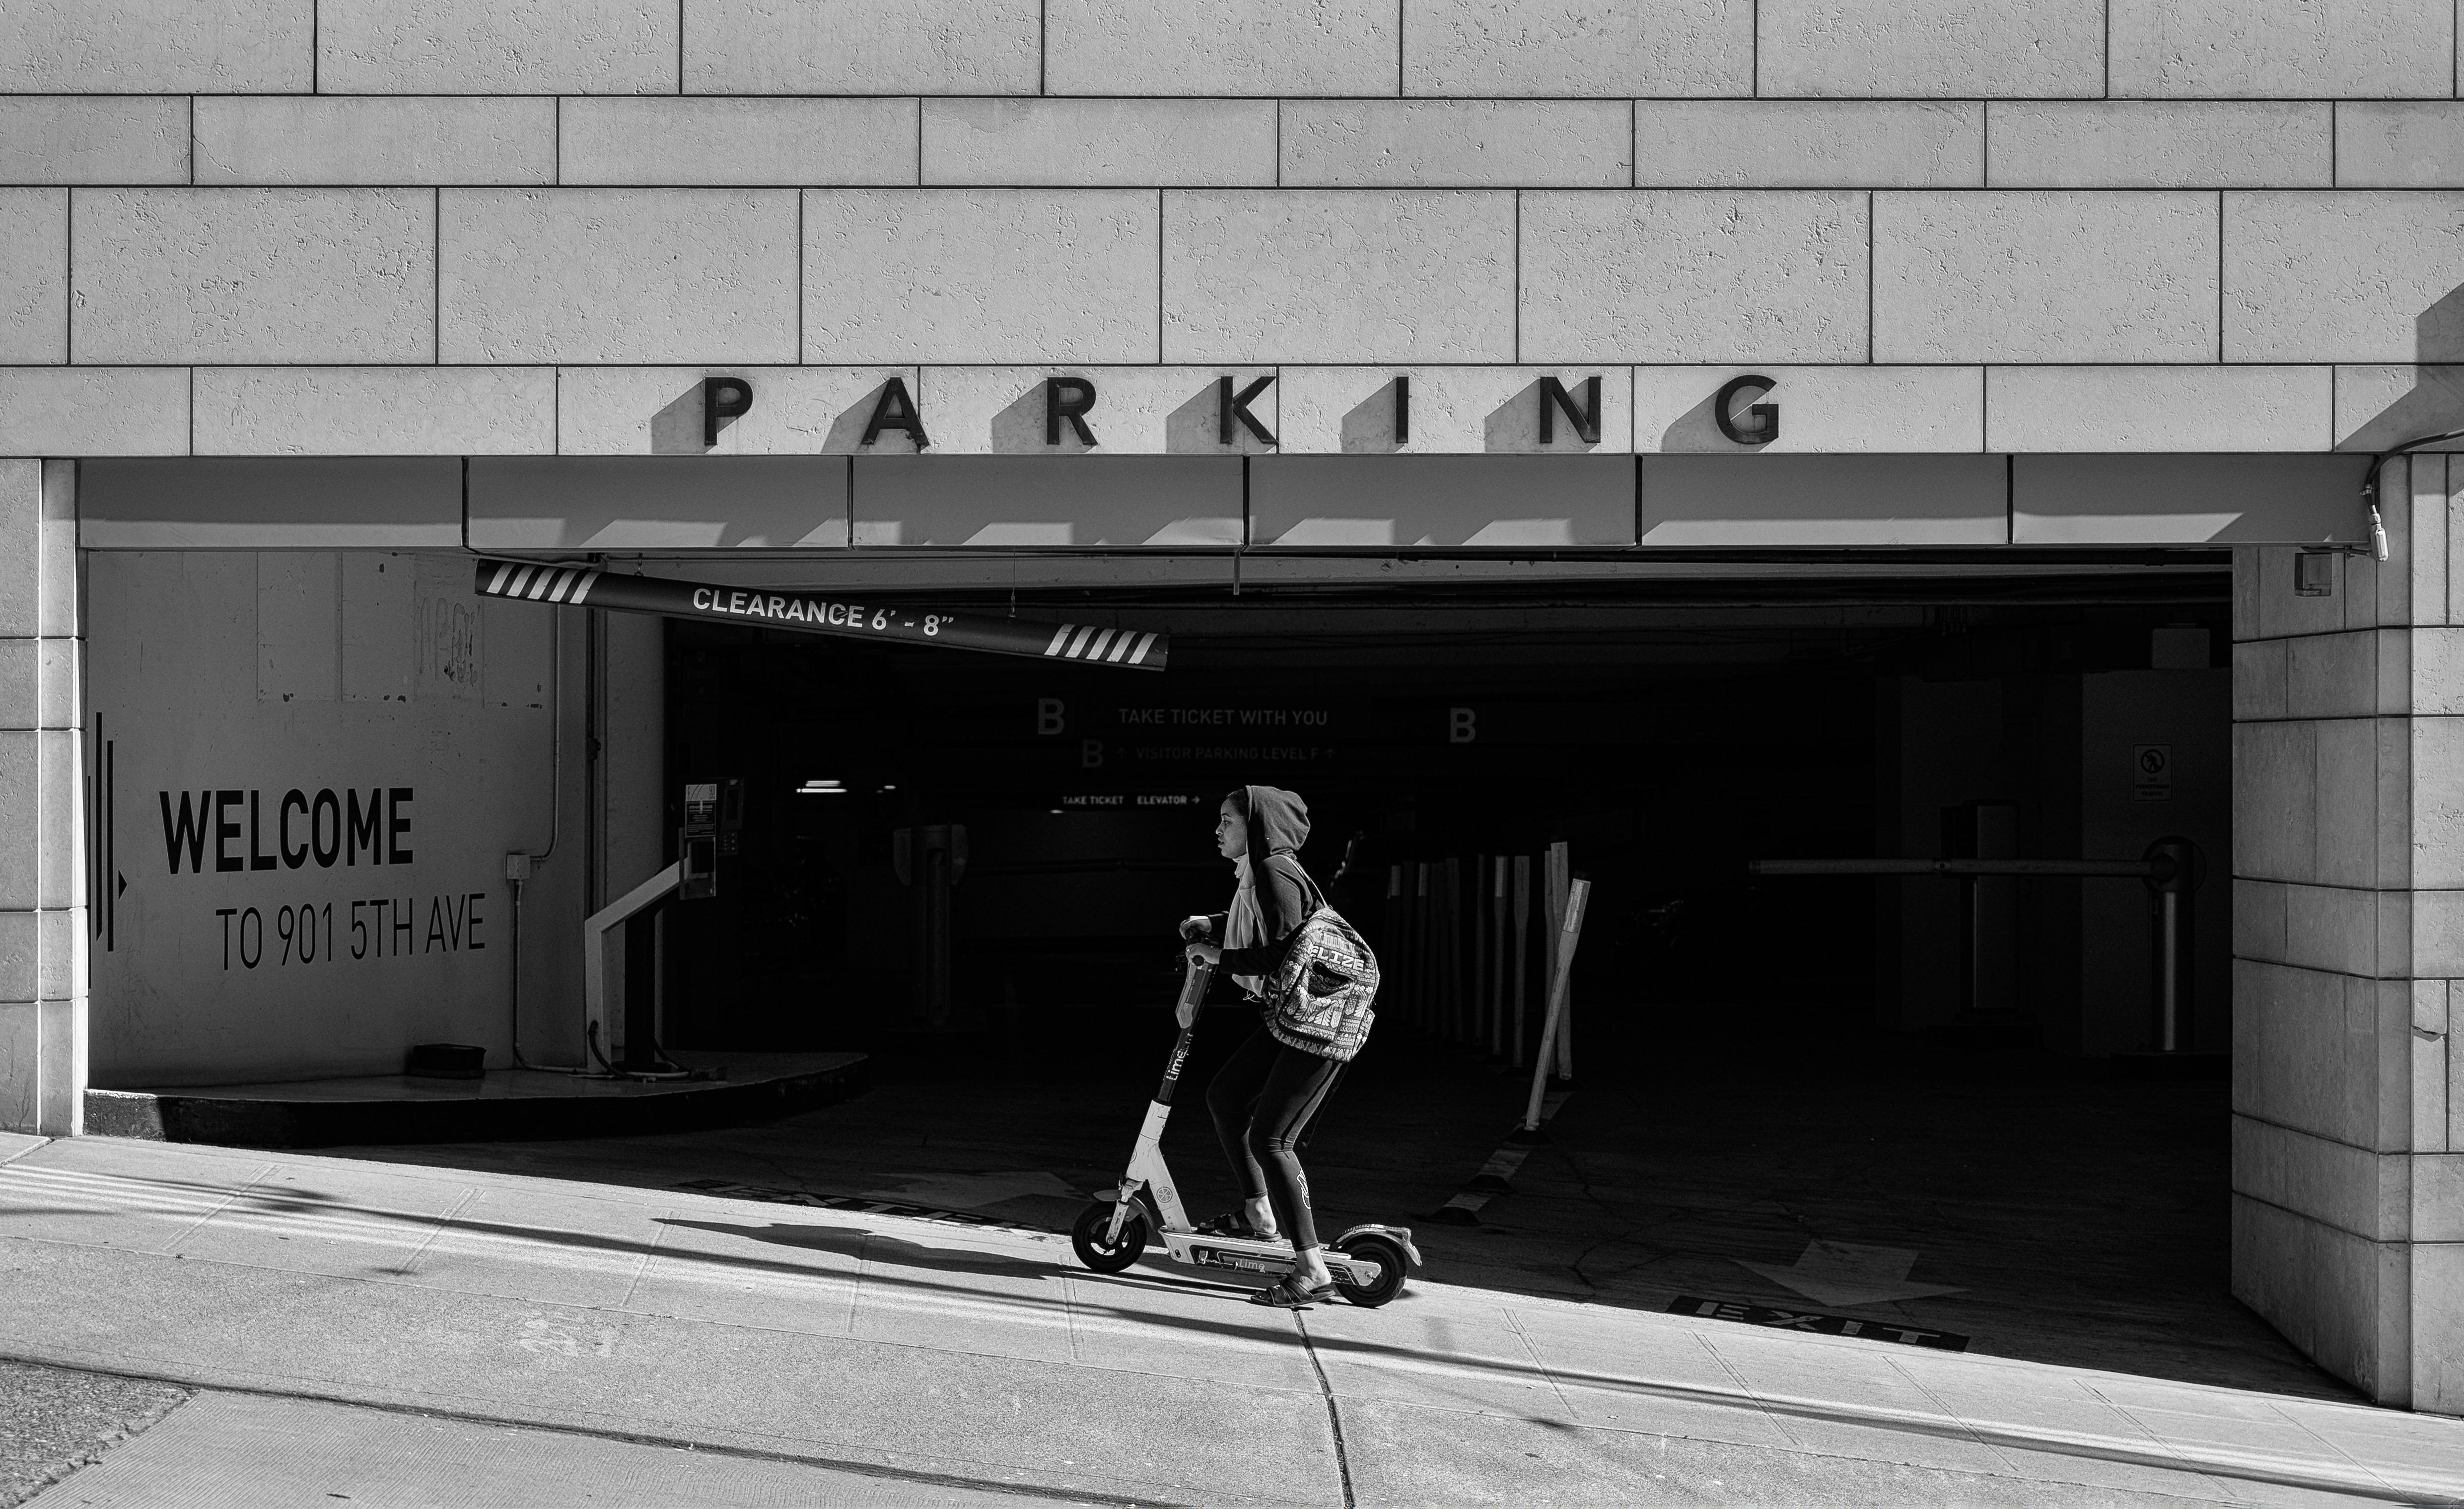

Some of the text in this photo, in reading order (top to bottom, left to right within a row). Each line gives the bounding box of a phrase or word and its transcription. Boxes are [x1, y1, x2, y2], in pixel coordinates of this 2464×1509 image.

[704, 374, 1779, 446] PARKING
[693, 588, 864, 628] CLEARANCE
[1038, 698, 1065, 735] B
[1119, 708, 1328, 726] TAKE TICKET WITH YOU
[1450, 708, 1477, 743] B
[1082, 739, 1104, 768] B
[1136, 747, 1319, 760] VISITOR PARKING LEVEL F
[1063, 795, 1124, 805] TAKE TICKET
[1137, 795, 1188, 805] ELEVATOR
[159, 787, 414, 874] WELCOME
[215, 893, 486, 971] TO 901 5TH AVE
[1696, 1300, 1940, 1344] EXIT
